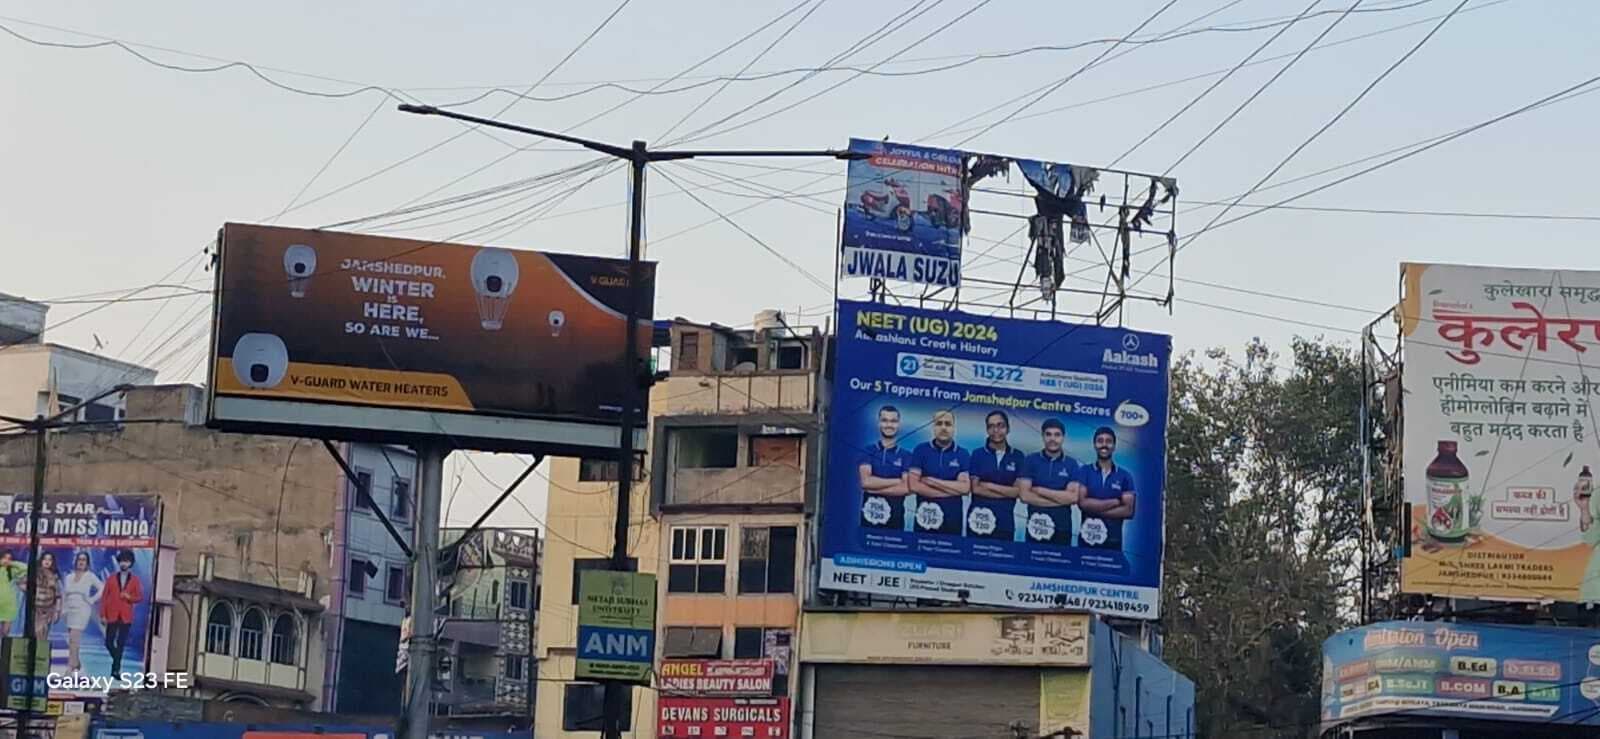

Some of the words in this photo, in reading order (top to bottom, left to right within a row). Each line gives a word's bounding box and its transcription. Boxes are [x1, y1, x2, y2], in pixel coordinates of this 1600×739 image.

[848, 251, 907, 280] JWALA
[913, 257, 959, 287] SUZU
[351, 276, 435, 299] WINTER
[387, 295, 398, 304] IS
[364, 302, 424, 324] HERE,
[345, 321, 366, 334] SO
[370, 323, 401, 337] ARE
[857, 310, 907, 330] NEET
[909, 316, 950, 337] (UG)
[952, 322, 998, 342] 2024
[919, 336, 957, 351] Create
[960, 341, 998, 357] History
[1102, 348, 1159, 367] Aakash
[973, 363, 1024, 382] 115272
[290, 374, 346, 389] V-GUARD
[350, 380, 391, 393] WATER
[394, 384, 449, 397] HEATERS
[1432, 373, 1494, 393] एनीमिया
[1499, 379, 1526, 393] कम
[1530, 376, 1566, 394] करने
[849, 377, 873, 390] Our
[874, 380, 882, 392] 5
[884, 381, 931, 398] Toppers
[932, 387, 961, 401] from
[962, 390, 1031, 409] Jamshedpur
[1033, 397, 1072, 413] Centre
[1073, 402, 1112, 417] Scores
[1120, 410, 1144, 420] 700+
[1440, 395, 1526, 416] हीमोग्लोबिन
[1531, 397, 1571, 419] बढ़ाने
[1450, 421, 1483, 442] बहुत
[1487, 423, 1524, 440] मदद
[1527, 424, 1568, 439] करता
[1572, 418, 1584, 443] है
[14, 501, 51, 514] FEL
[55, 502, 95, 514] STAR
[53, 518, 98, 536] MISS
[104, 518, 149, 536] INDIA
[839, 556, 896, 569] ADMISSIONS
[897, 561, 922, 570] OPEN
[833, 571, 867, 585] NEET
[877, 575, 900, 588] JEE
[1018, 592, 1081, 606] 92341748
[1030, 581, 1098, 596] JAMSHEDPUR
[1100, 588, 1140, 600] CENTRE
[584, 631, 649, 656] ANM
[1433, 627, 1479, 650] Open
[661, 663, 704, 676] ANGEL
[1457, 661, 1488, 672] B.Ed
[11, 679, 46, 694] GM
[696, 678, 735, 690] BEAUTY
[736, 678, 771, 691] SALON
[1497, 685, 1521, 696] B.A
[661, 707, 708, 720] DEVANS
[713, 707, 781, 722] SURGICALS
